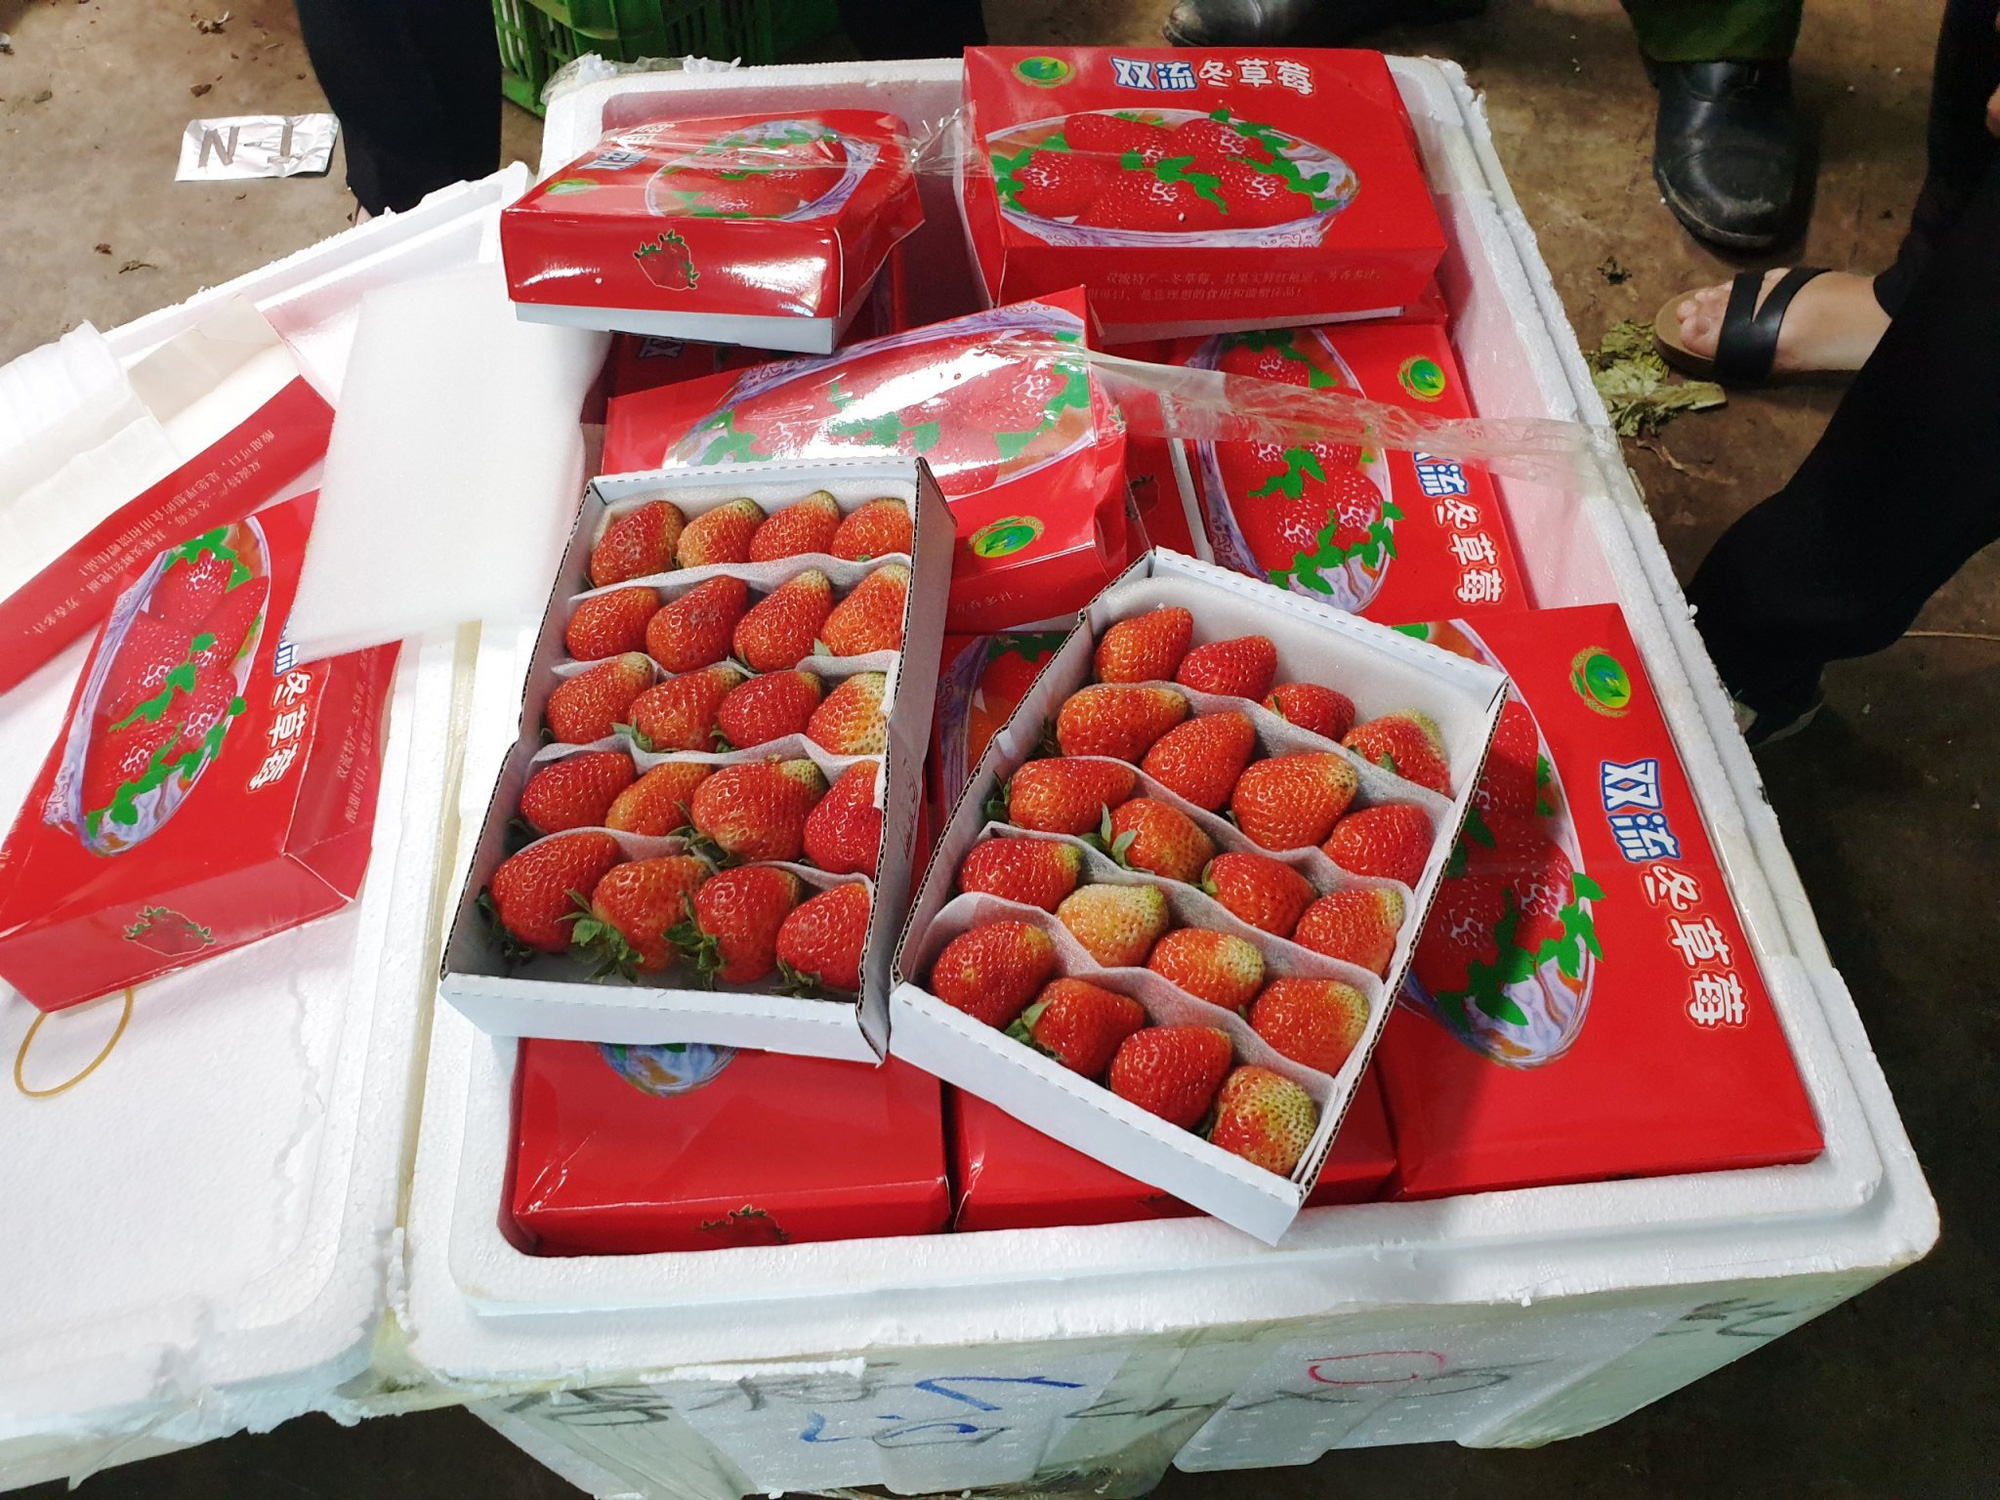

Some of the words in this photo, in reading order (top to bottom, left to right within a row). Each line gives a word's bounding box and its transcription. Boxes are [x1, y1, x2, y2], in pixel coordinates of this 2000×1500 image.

[1111, 57, 1314, 95] 双流冬草莓
[1601, 759, 1746, 1026] 双流冬草莓
